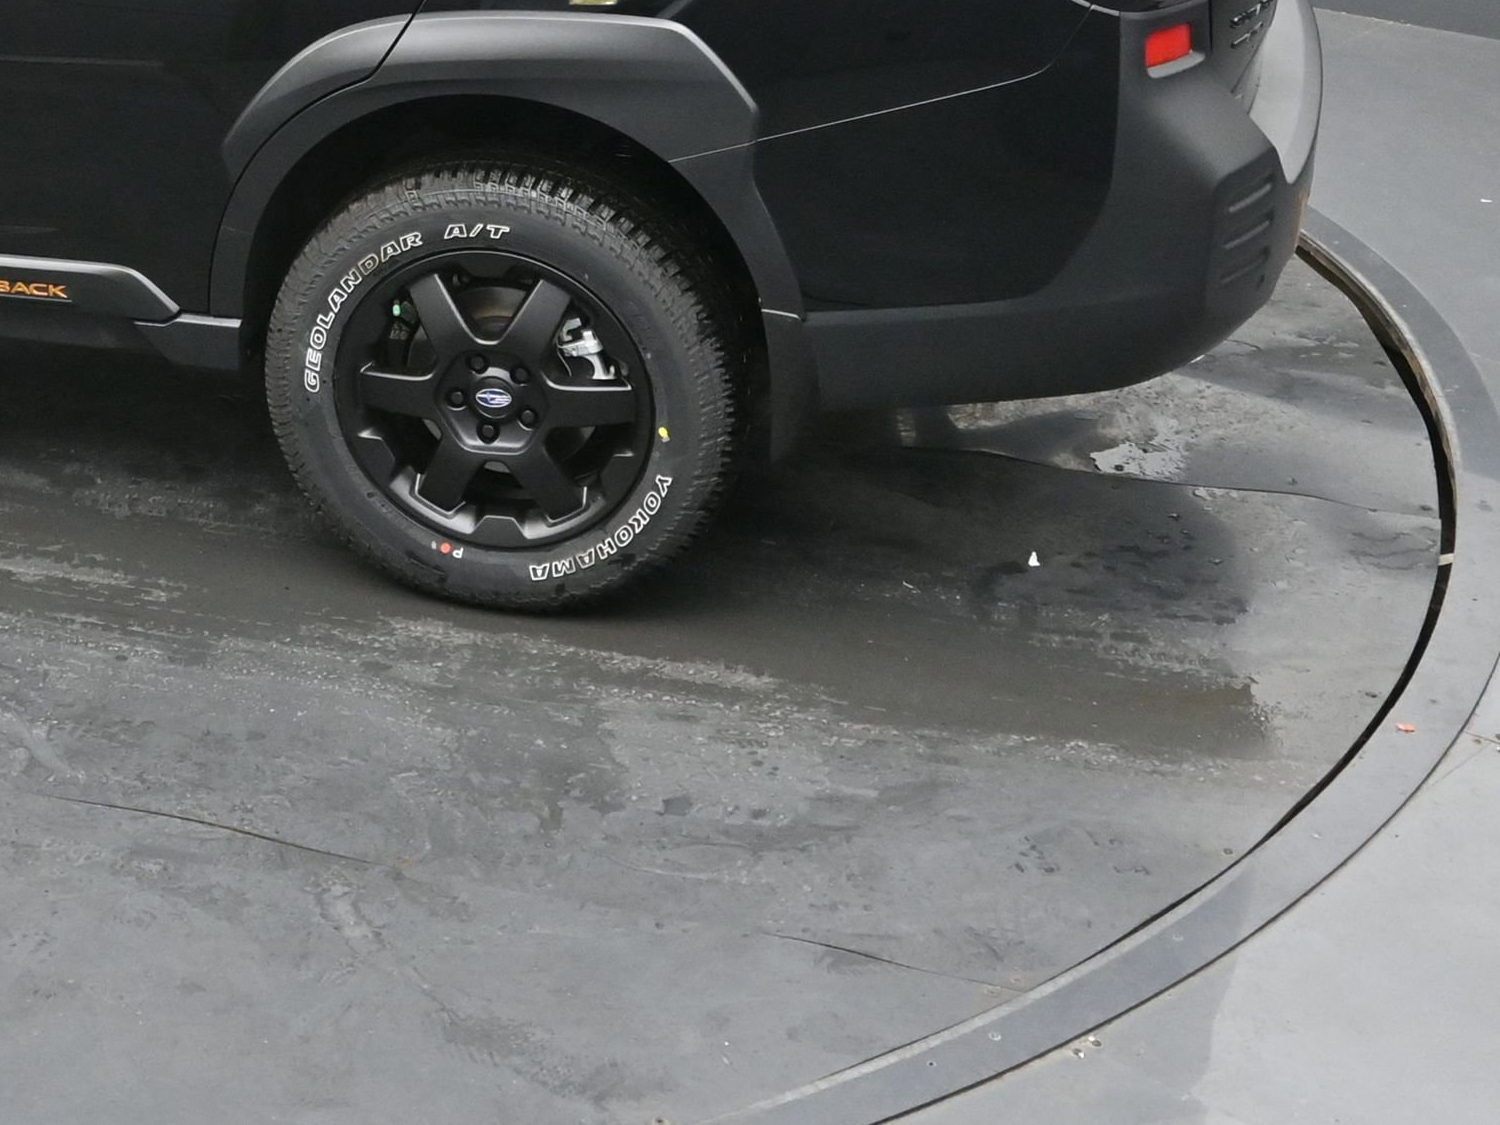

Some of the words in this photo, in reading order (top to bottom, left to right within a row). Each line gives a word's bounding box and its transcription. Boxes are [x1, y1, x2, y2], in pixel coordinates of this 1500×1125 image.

[303, 231, 423, 393] GEOLANDAR
[444, 223, 510, 240] A/T
[529, 474, 673, 581] YOKOHAMA
